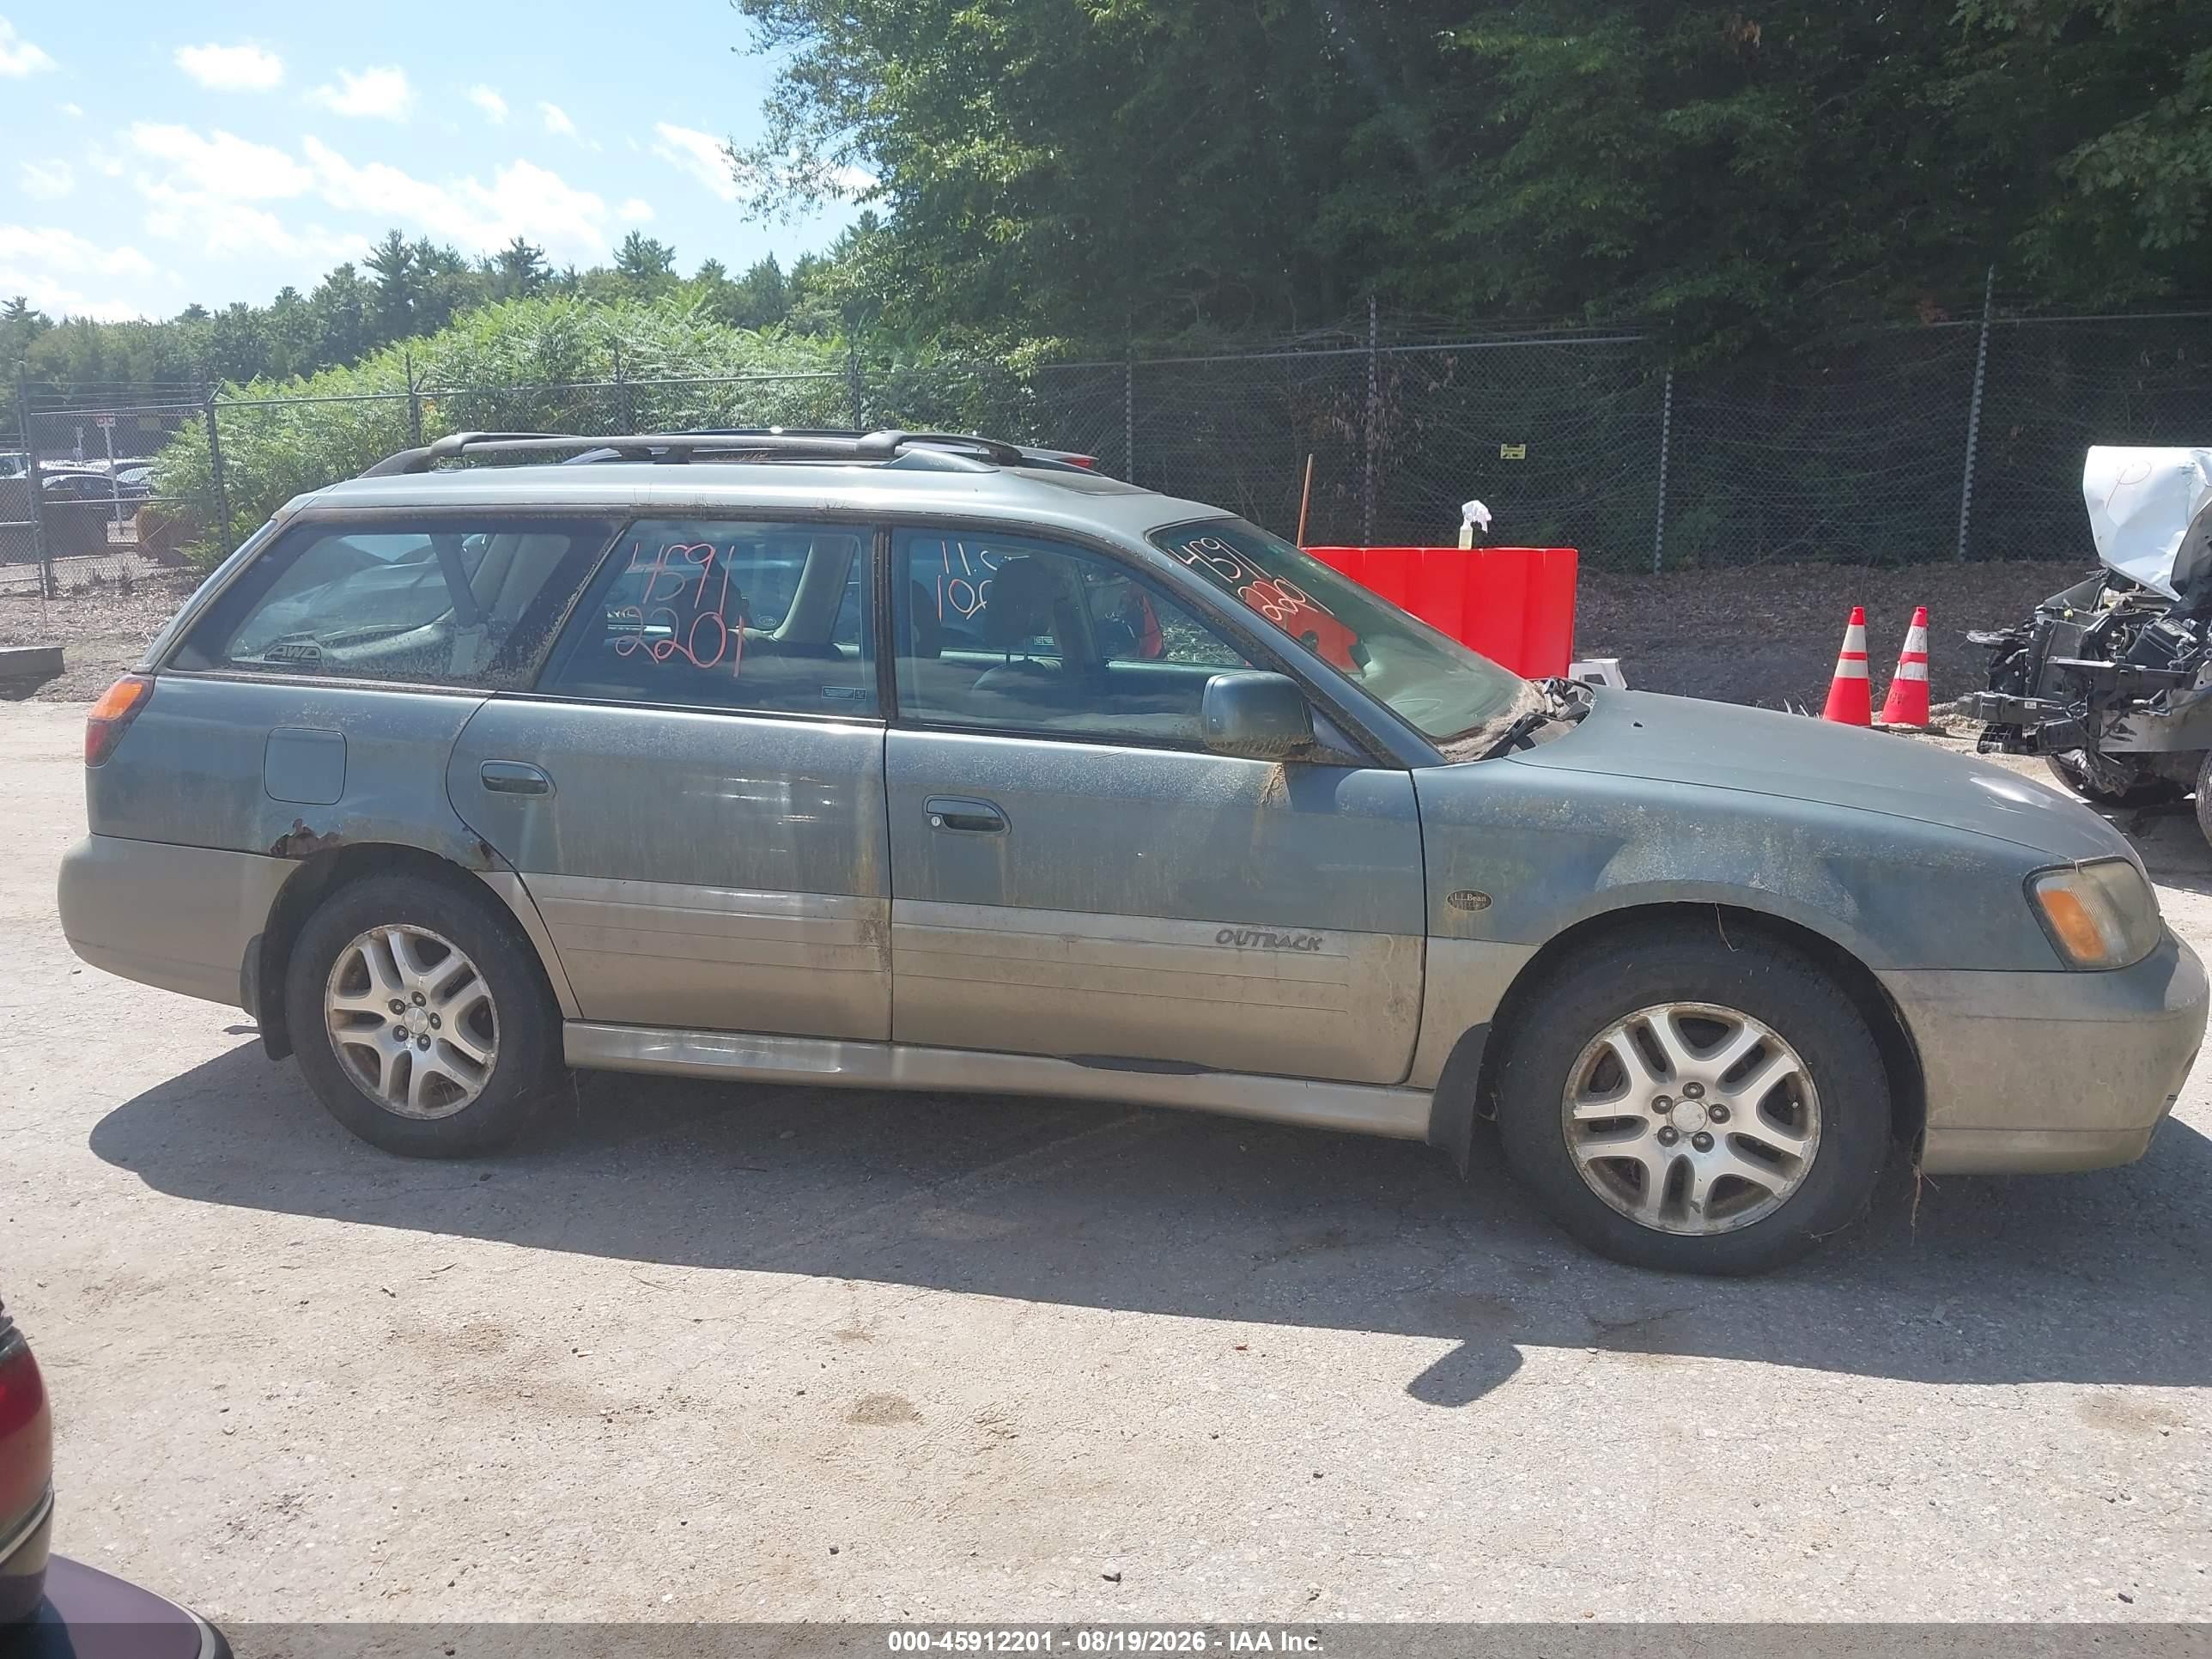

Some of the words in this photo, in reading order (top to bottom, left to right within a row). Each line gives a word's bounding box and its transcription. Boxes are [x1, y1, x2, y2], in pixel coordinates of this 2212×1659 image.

[625, 541, 735, 617] 4591
[1167, 537, 1273, 584] 4591
[615, 604, 744, 678] 2201
[1215, 928, 1323, 951] OUTBACK
